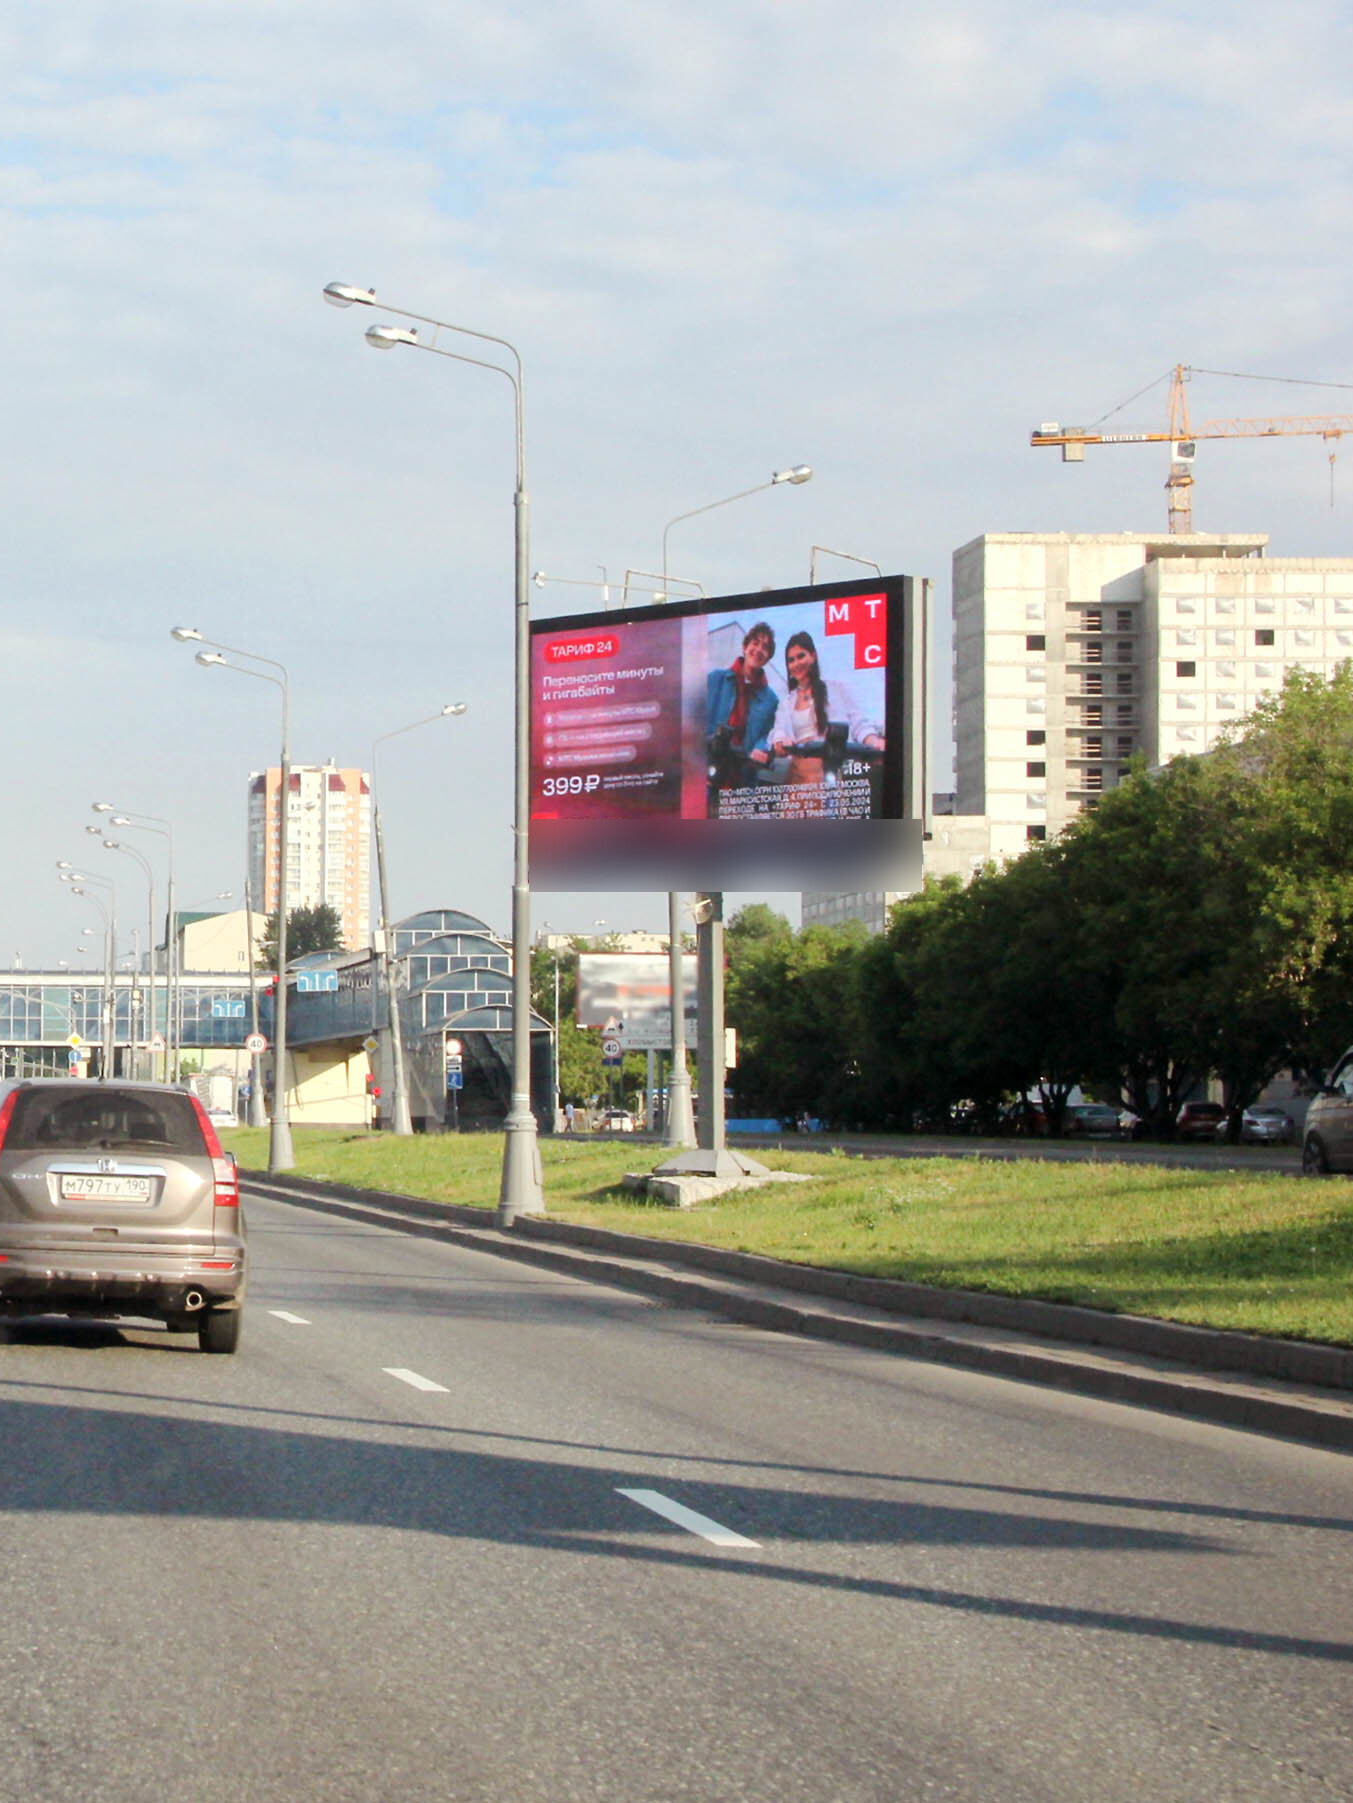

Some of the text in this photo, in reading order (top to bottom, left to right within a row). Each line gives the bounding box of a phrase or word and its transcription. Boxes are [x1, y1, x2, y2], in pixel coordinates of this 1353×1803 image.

[551, 641, 613, 658] ТАРИФ 24
[542, 666, 664, 688] Переносите минуты
[542, 684, 615, 701] и гигабайты
[605, 1044, 618, 1052] 40
